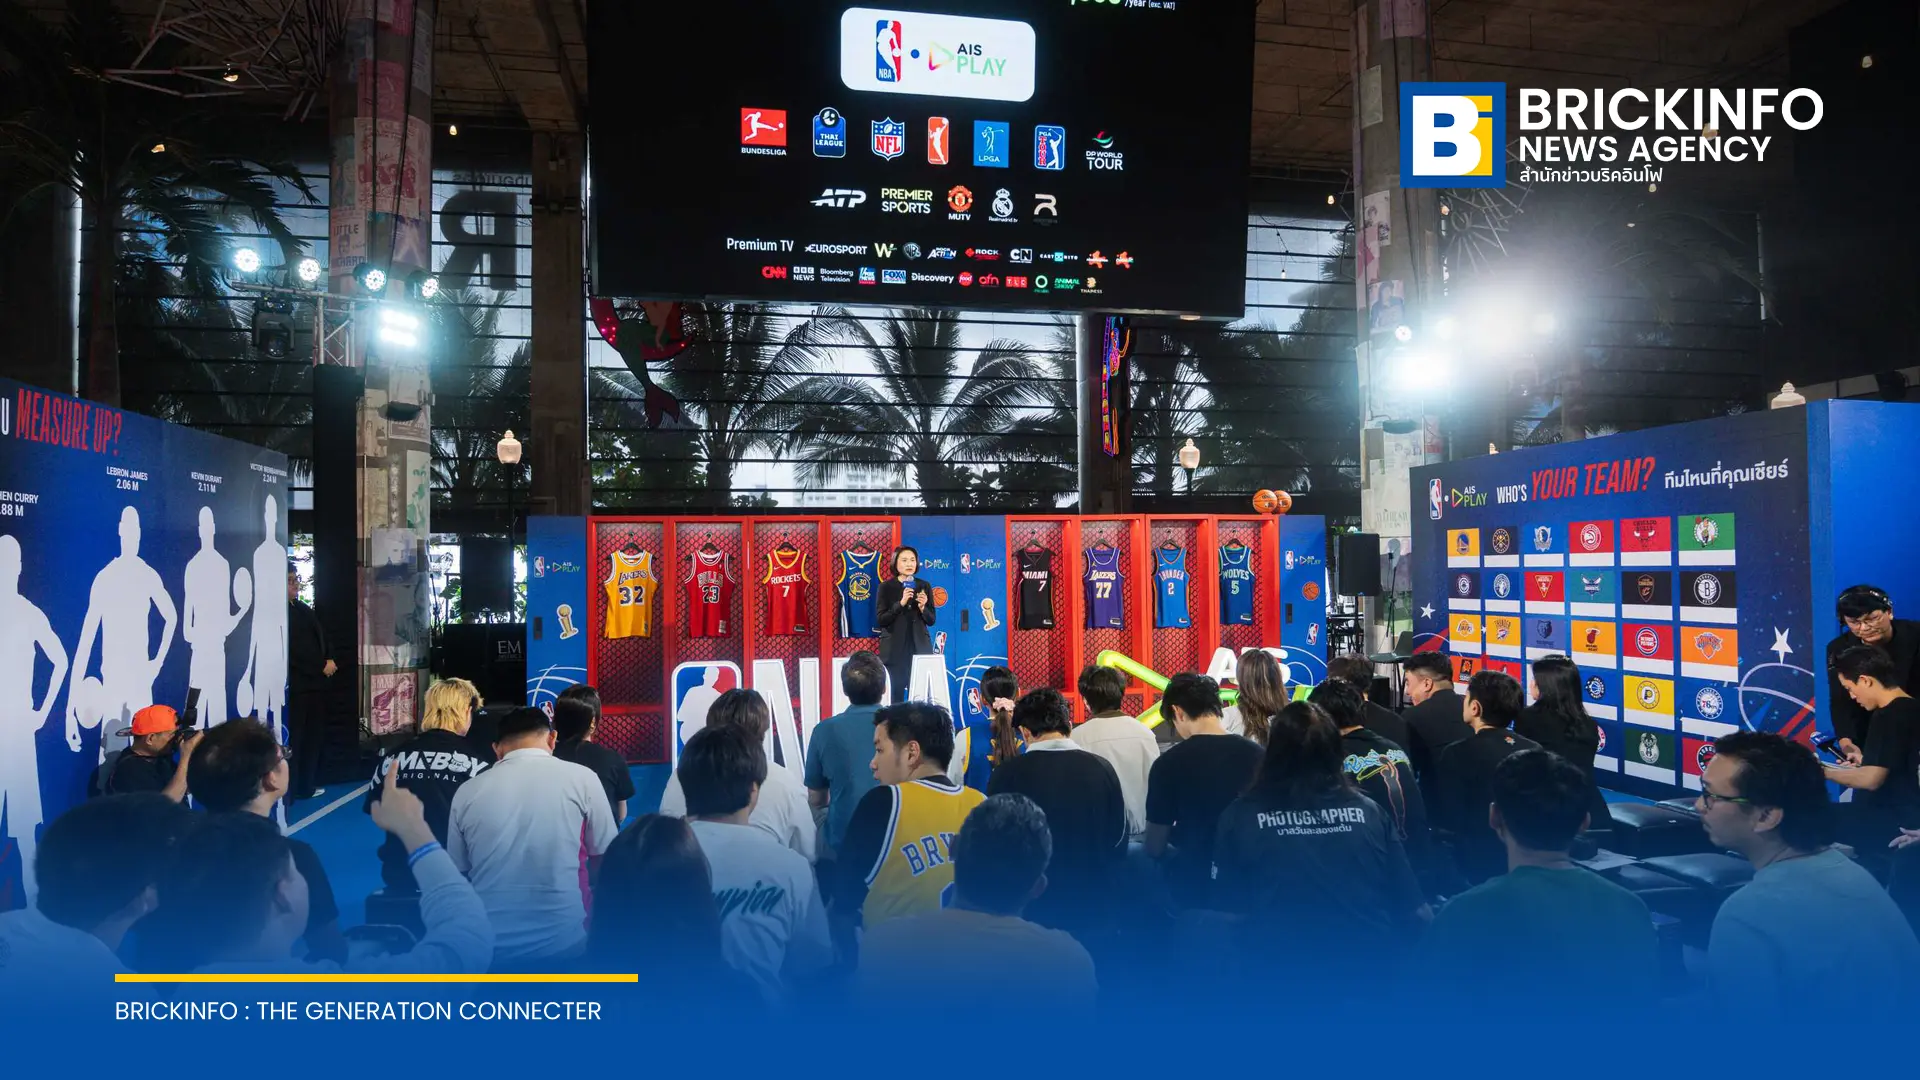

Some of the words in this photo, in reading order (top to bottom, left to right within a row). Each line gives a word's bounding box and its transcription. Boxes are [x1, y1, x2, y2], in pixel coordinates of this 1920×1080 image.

[957, 43, 982, 56] AIS
[957, 56, 1006, 77] PLAY
[878, 68, 893, 80] NBA
[815, 139, 844, 147] LEAGUE
[875, 136, 901, 154] NFL
[741, 147, 787, 156] BUNDESLIGA
[1086, 150, 1096, 158] DP
[1096, 151, 1123, 159] WORLD
[978, 155, 1001, 163] LPGA
[1086, 157, 1123, 171] TOUR
[811, 188, 867, 208] ATP
[881, 187, 933, 201] PREMIER
[881, 200, 932, 214] SPORTS
[948, 213, 971, 221] MUTV
[726, 238, 778, 251] Premium
[780, 239, 794, 252] TV
[808, 243, 868, 255] EUROSPORT
[761, 266, 787, 278] CNN
[820, 268, 854, 277] Bloomberg
[911, 272, 954, 284] Discovery
[821, 275, 851, 283] Television
[15, 387, 91, 451] MEASURE
[93, 407, 122, 457] UP?
[106, 466, 129, 478] LEBRON
[129, 469, 149, 481] JAMES
[191, 472, 204, 482] KEVIN
[204, 474, 223, 484] DURANT
[1531, 468, 1579, 501] YOUR
[1583, 455, 1657, 497] TEAM?
[1664, 458, 1790, 490] ทีมไหนที่คุณเชียร์
[116, 479, 132, 491] 2.06
[132, 481, 139, 492] M
[198, 482, 210, 493] 2.11
[210, 483, 216, 493] M
[1464, 485, 1476, 495] AIS
[14, 492, 39, 504] CURRY
[1464, 493, 1487, 508] PLAY
[15, 504, 24, 517] M
[618, 570, 649, 586] LAKERS
[697, 571, 724, 588] BULLS
[1022, 571, 1048, 580] MIAMI
[1222, 568, 1250, 581] WOLVES
[781, 585, 790, 598] 7
[1038, 580, 1047, 592] 7
[1095, 582, 1112, 599] 77
[1167, 582, 1175, 595] 2
[1231, 580, 1240, 595] 5
[618, 586, 645, 606] 32
[702, 586, 720, 603] 23
